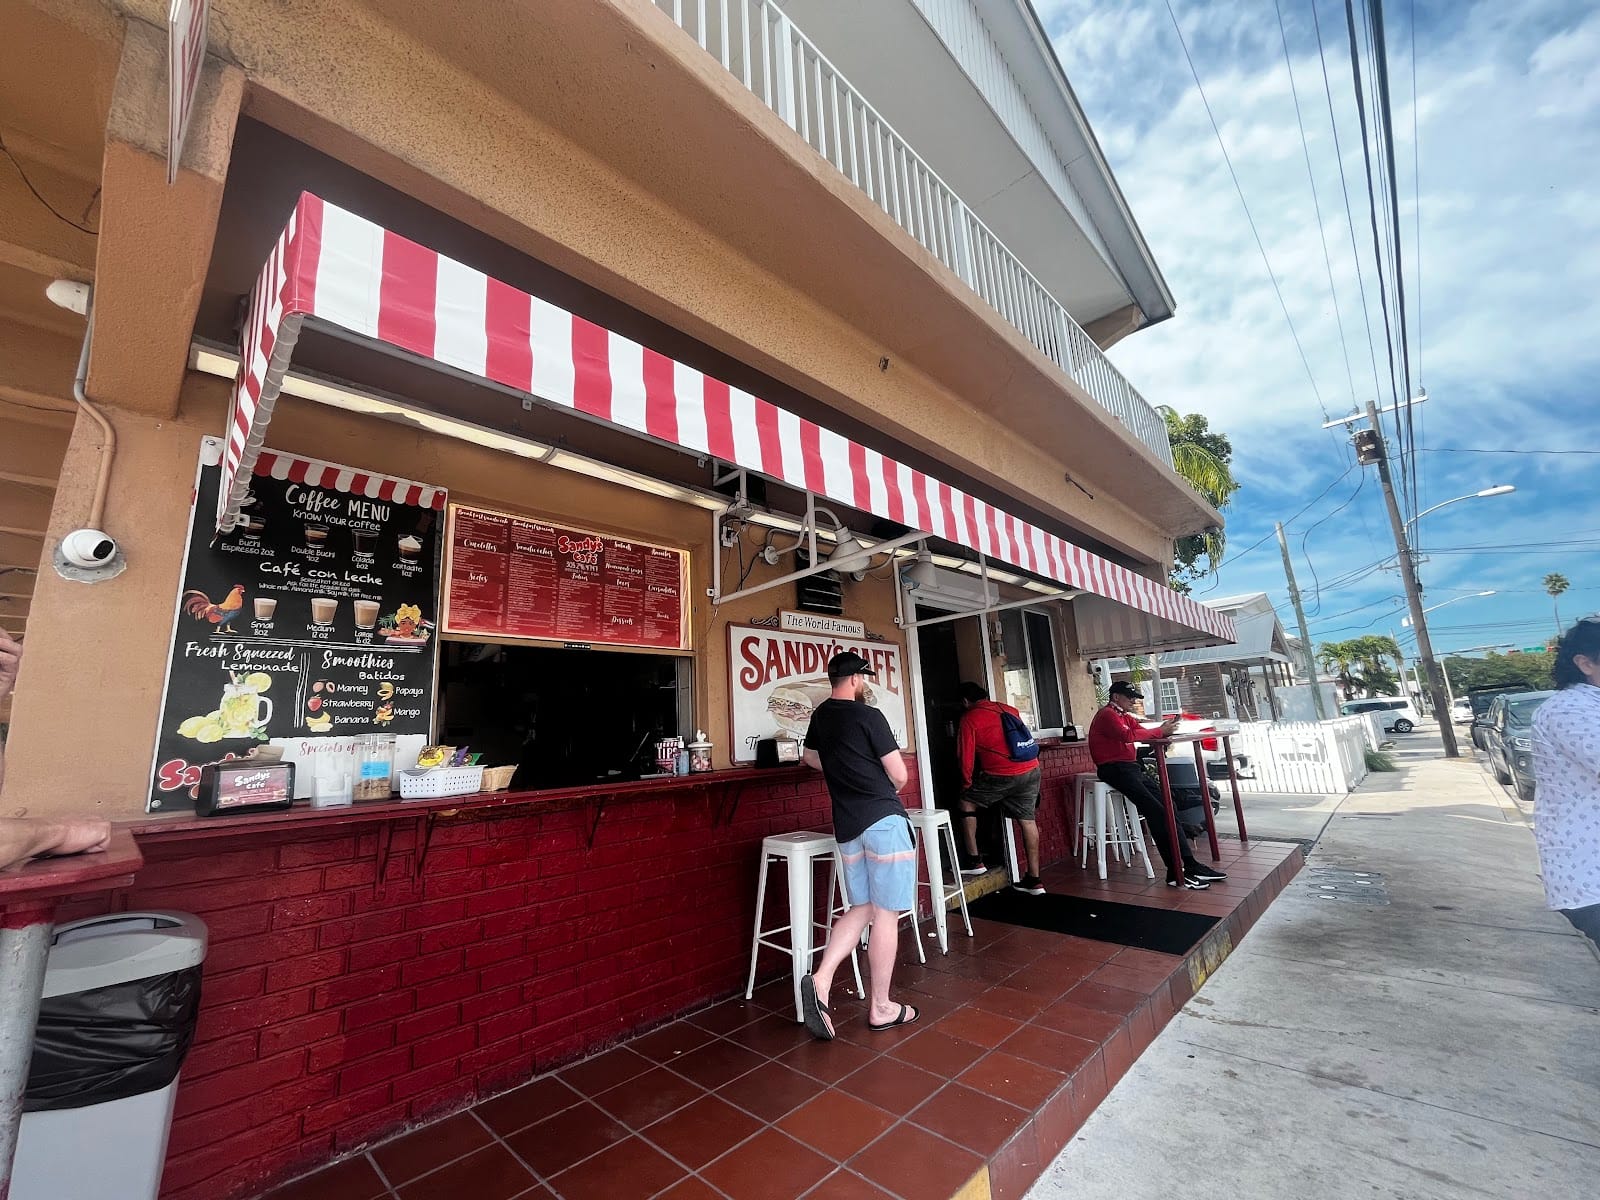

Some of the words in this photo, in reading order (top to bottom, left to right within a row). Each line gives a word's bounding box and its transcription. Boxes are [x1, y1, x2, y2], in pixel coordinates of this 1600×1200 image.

[285, 484, 340, 512] Coffee
[347, 499, 390, 522] MENU
[292, 508, 322, 521] Know
[221, 543, 259, 555] Espresso
[558, 535, 603, 553] Sandy's
[259, 561, 301, 577] Café
[307, 569, 337, 580] con
[344, 570, 383, 586] Leche
[250, 621, 275, 630] Small
[786, 614, 803, 626] The
[803, 616, 830, 631] World
[831, 622, 862, 634] Famous
[185, 641, 230, 658] Fresh
[232, 642, 296, 664] Squeezed
[321, 649, 395, 670] Smoothies
[221, 660, 300, 673] Lemonade
[358, 670, 406, 681] Batidos
[336, 684, 369, 696] Mamey
[395, 686, 424, 698] Papaya
[321, 698, 375, 711] Strawberry
[333, 714, 370, 725] Banana
[393, 707, 421, 719] Mango
[300, 741, 343, 757] Specials
[234, 769, 271, 787] Sandy's
